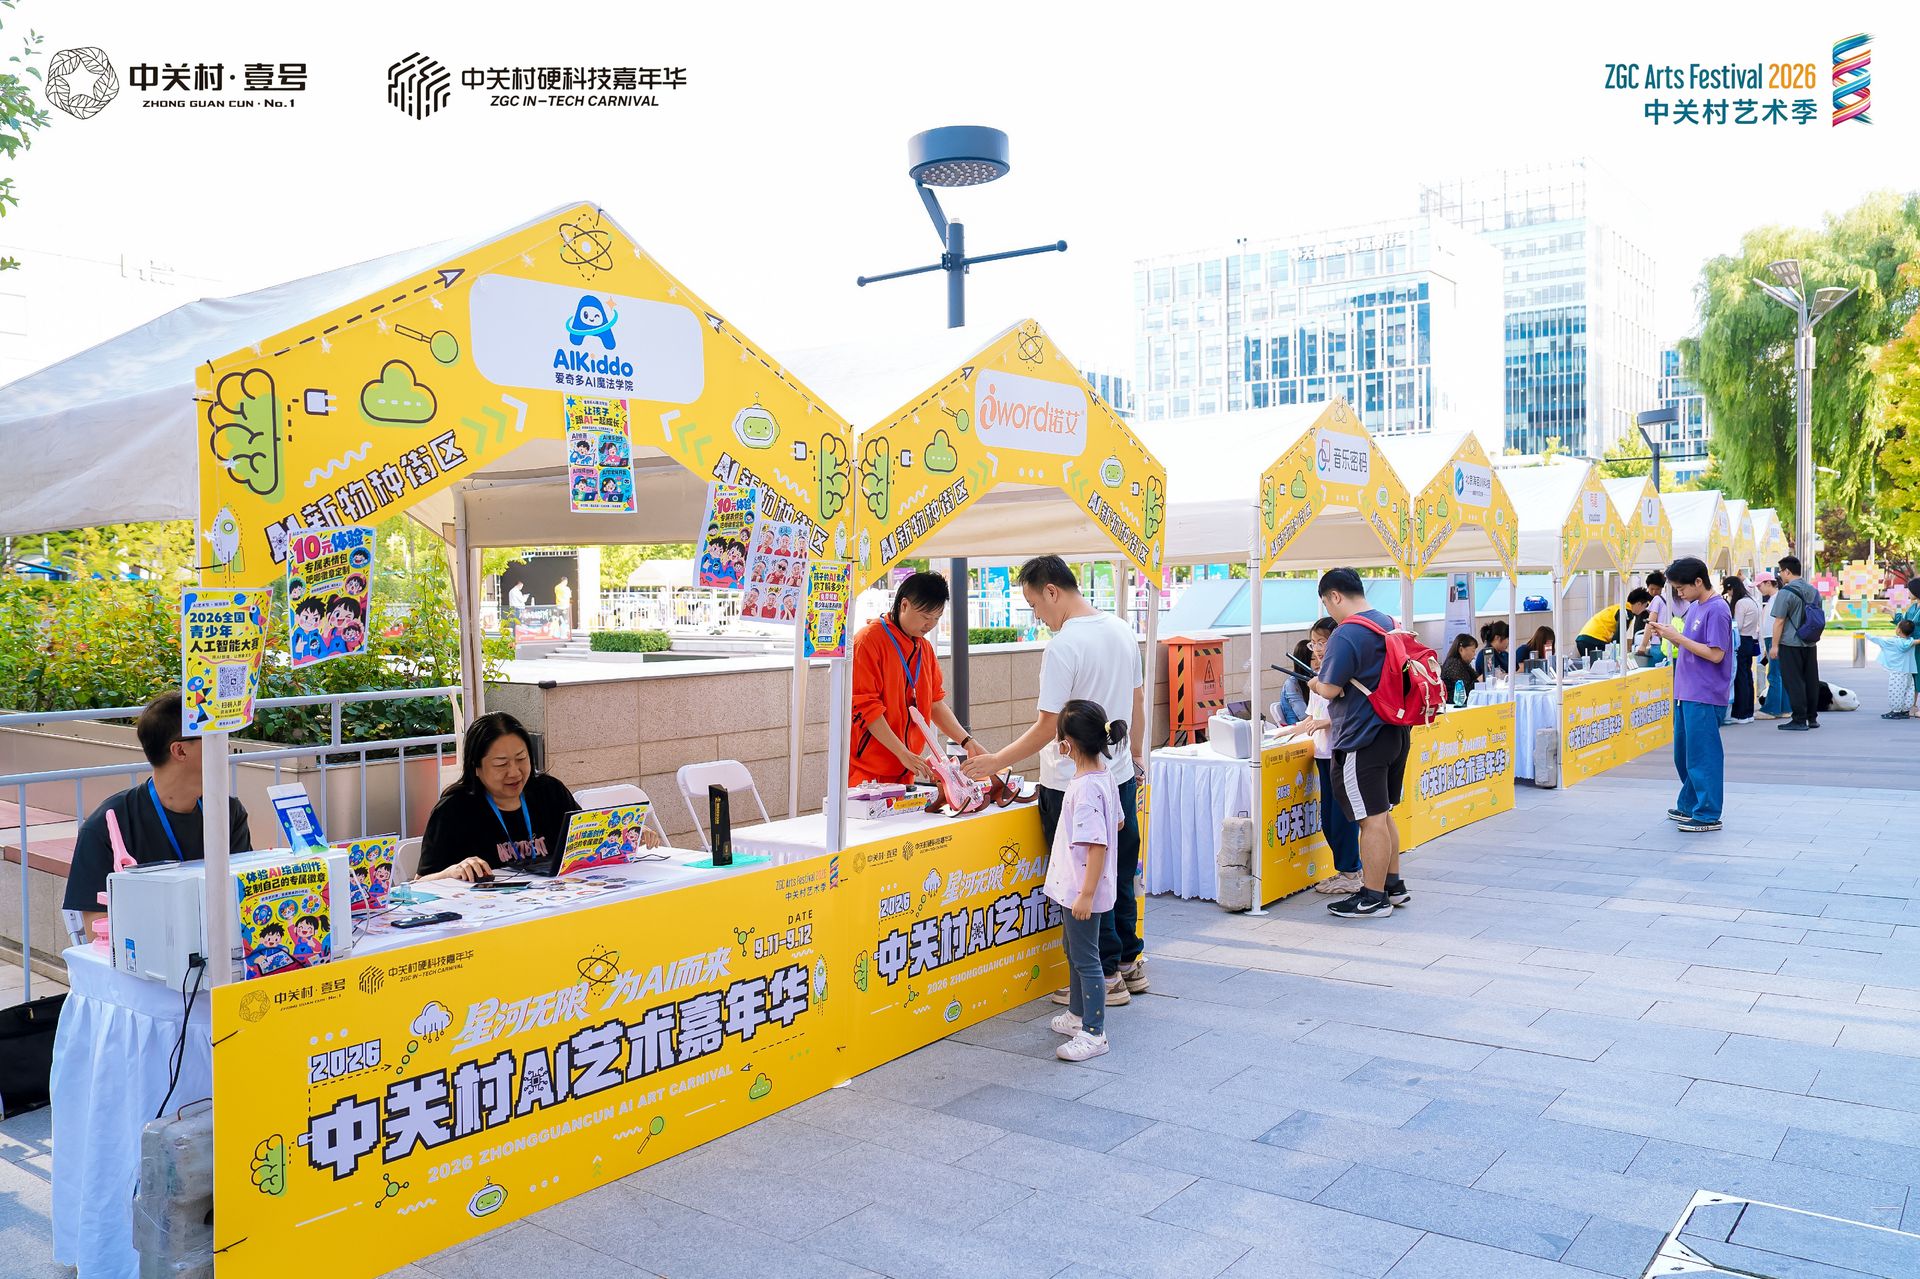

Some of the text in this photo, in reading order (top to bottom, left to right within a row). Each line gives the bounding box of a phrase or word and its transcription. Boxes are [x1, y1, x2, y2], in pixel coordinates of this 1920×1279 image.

[553, 348, 634, 377] AIKiddo
[555, 372, 634, 391] 爱奇多AI魔法学院
[1333, 447, 1368, 472] 音乐密码
[717, 497, 752, 514] 10元体验
[880, 476, 970, 564] AI新物种街区
[1087, 490, 1150, 565] AI新物种街区
[292, 527, 364, 564] 10元体验
[304, 553, 348, 574] 专属表情包
[189, 611, 246, 623] 2026全国
[189, 624, 233, 639] 青少年
[189, 637, 259, 653] 人工智能大赛
[1420, 748, 1506, 800] 中关村AI艺术嘉年华
[1276, 799, 1322, 846] 中关村
[243, 872, 326, 897] 定制自己的专属徽章
[245, 861, 322, 884] 体验AI绘画创作
[940, 863, 1006, 907] 星河无限
[787, 909, 813, 925] DATE
[879, 891, 911, 919] 2026
[754, 923, 813, 960] 9.11-9.12
[274, 978, 346, 1005] 中关村·壹号
[449, 946, 734, 1055] 星河无限 为AI而来
[307, 963, 811, 1182] 中关村AI艺术嘉年华
[308, 1038, 381, 1085] 2026
[427, 1064, 734, 1183] 2026 ZHONGGUANCUN AI ART CARNIVAL
